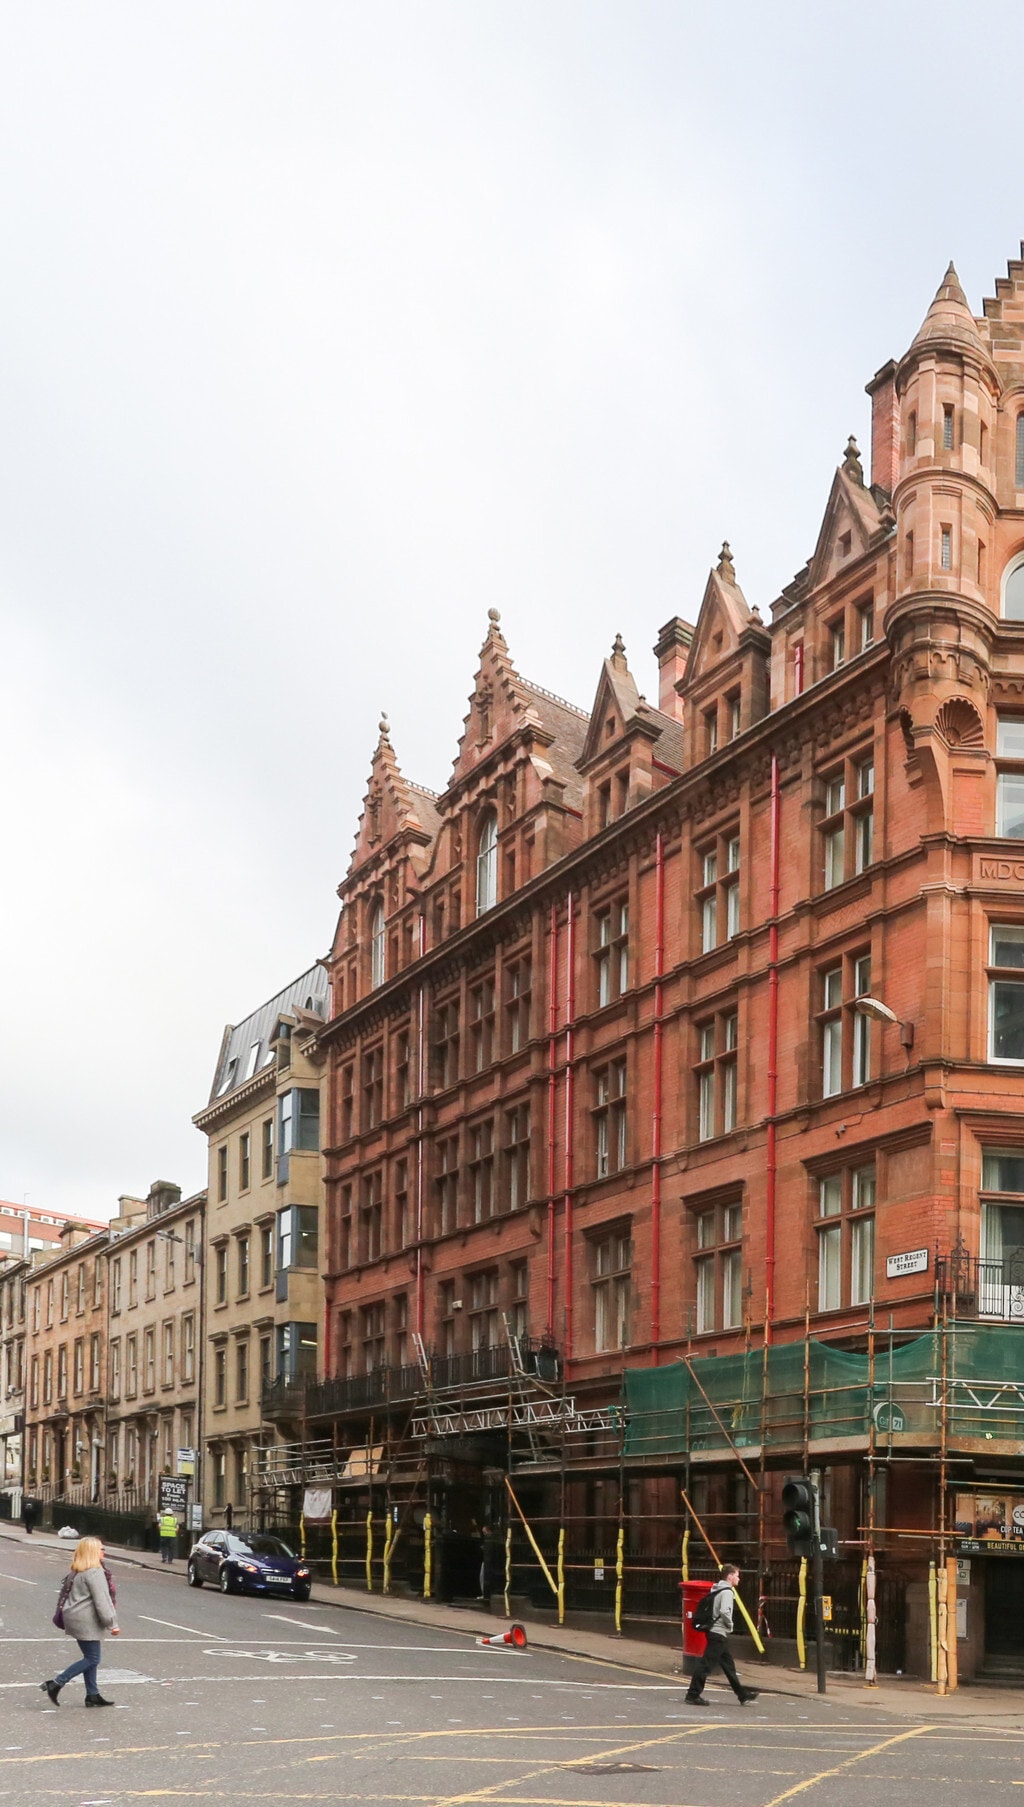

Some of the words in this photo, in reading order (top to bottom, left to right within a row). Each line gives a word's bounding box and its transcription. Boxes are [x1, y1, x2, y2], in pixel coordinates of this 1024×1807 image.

[888, 1256, 903, 1264] WEST
[905, 1252, 926, 1261] REGENT
[896, 1261, 917, 1270] STREET
[1000, 1525, 1012, 1533] CUP
[1013, 1526, 1023, 1534] TEA
[987, 1542, 1017, 1551] BEAUTIFUL
